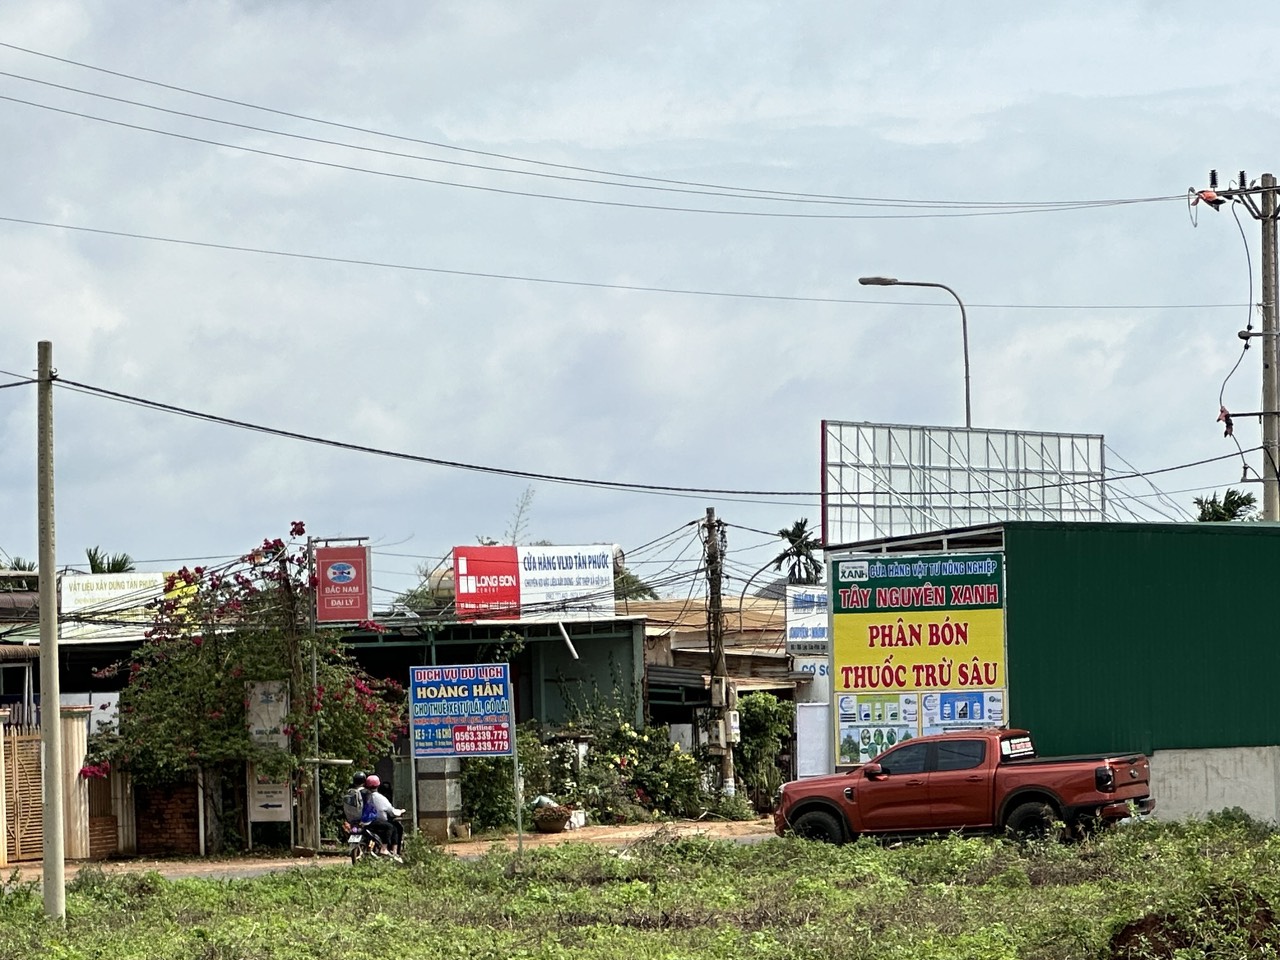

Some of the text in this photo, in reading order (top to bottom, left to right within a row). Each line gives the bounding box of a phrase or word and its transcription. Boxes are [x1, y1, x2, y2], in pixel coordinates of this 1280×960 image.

[523, 551, 609, 571] CỬA HÀNG VLXD TÂN PHƯỚC
[870, 557, 998, 580] CỬA HÀNG VẬT TƯ NÔNG NGHIỆP
[476, 575, 499, 587] LONG
[839, 583, 872, 608] TÂY
[876, 581, 946, 608] NGUYÊN
[950, 583, 999, 605] XANH
[868, 615, 968, 647] PHÂN BÓN
[415, 666, 503, 684] DỊCH VỤ DU LỊCH
[841, 654, 998, 689] THUỐC TRỪ SÂU
[416, 681, 504, 699] HOÀNG HÂN
[414, 702, 429, 716] CHO
[429, 699, 448, 715] THUÊ
[448, 701, 458, 715] XE
[459, 700, 470, 717] TỰ
[485, 697, 497, 713] CÓ
[497, 697, 509, 713] LÁI
[455, 730, 508, 741] 0563.339.779
[455, 741, 509, 752] 0569.339.779
